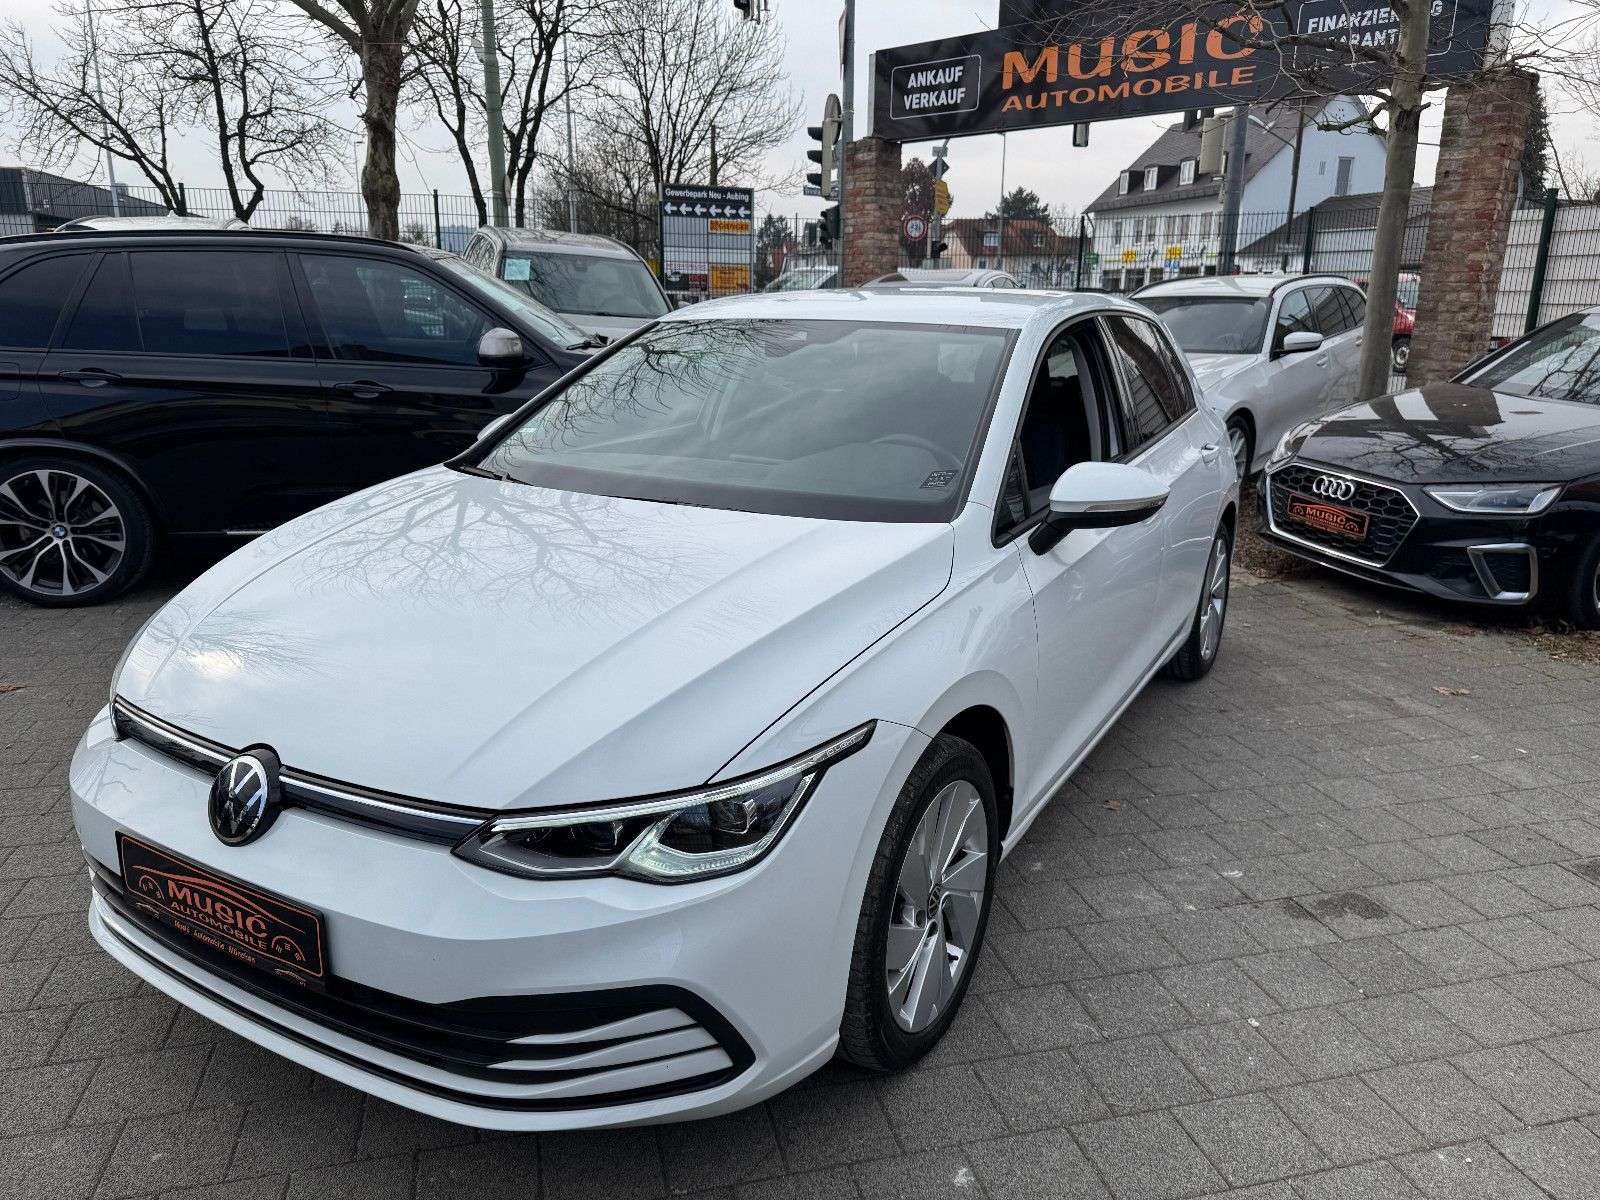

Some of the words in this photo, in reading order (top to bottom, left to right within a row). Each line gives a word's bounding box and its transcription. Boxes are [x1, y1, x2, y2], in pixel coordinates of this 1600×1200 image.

[1002, 14, 1263, 90] MUSIC
[907, 65, 964, 89] ANKAUF
[1001, 65, 1256, 112] AUTOMOBILE
[903, 87, 966, 111] VERKAUF
[664, 188, 708, 199] Gewerbepark
[708, 190, 721, 200] Neu
[727, 191, 749, 203] Aubing
[1306, 507, 1346, 525] MUSIC
[167, 880, 268, 938] MUSIC
[171, 901, 267, 951] AUTOMOBILE
